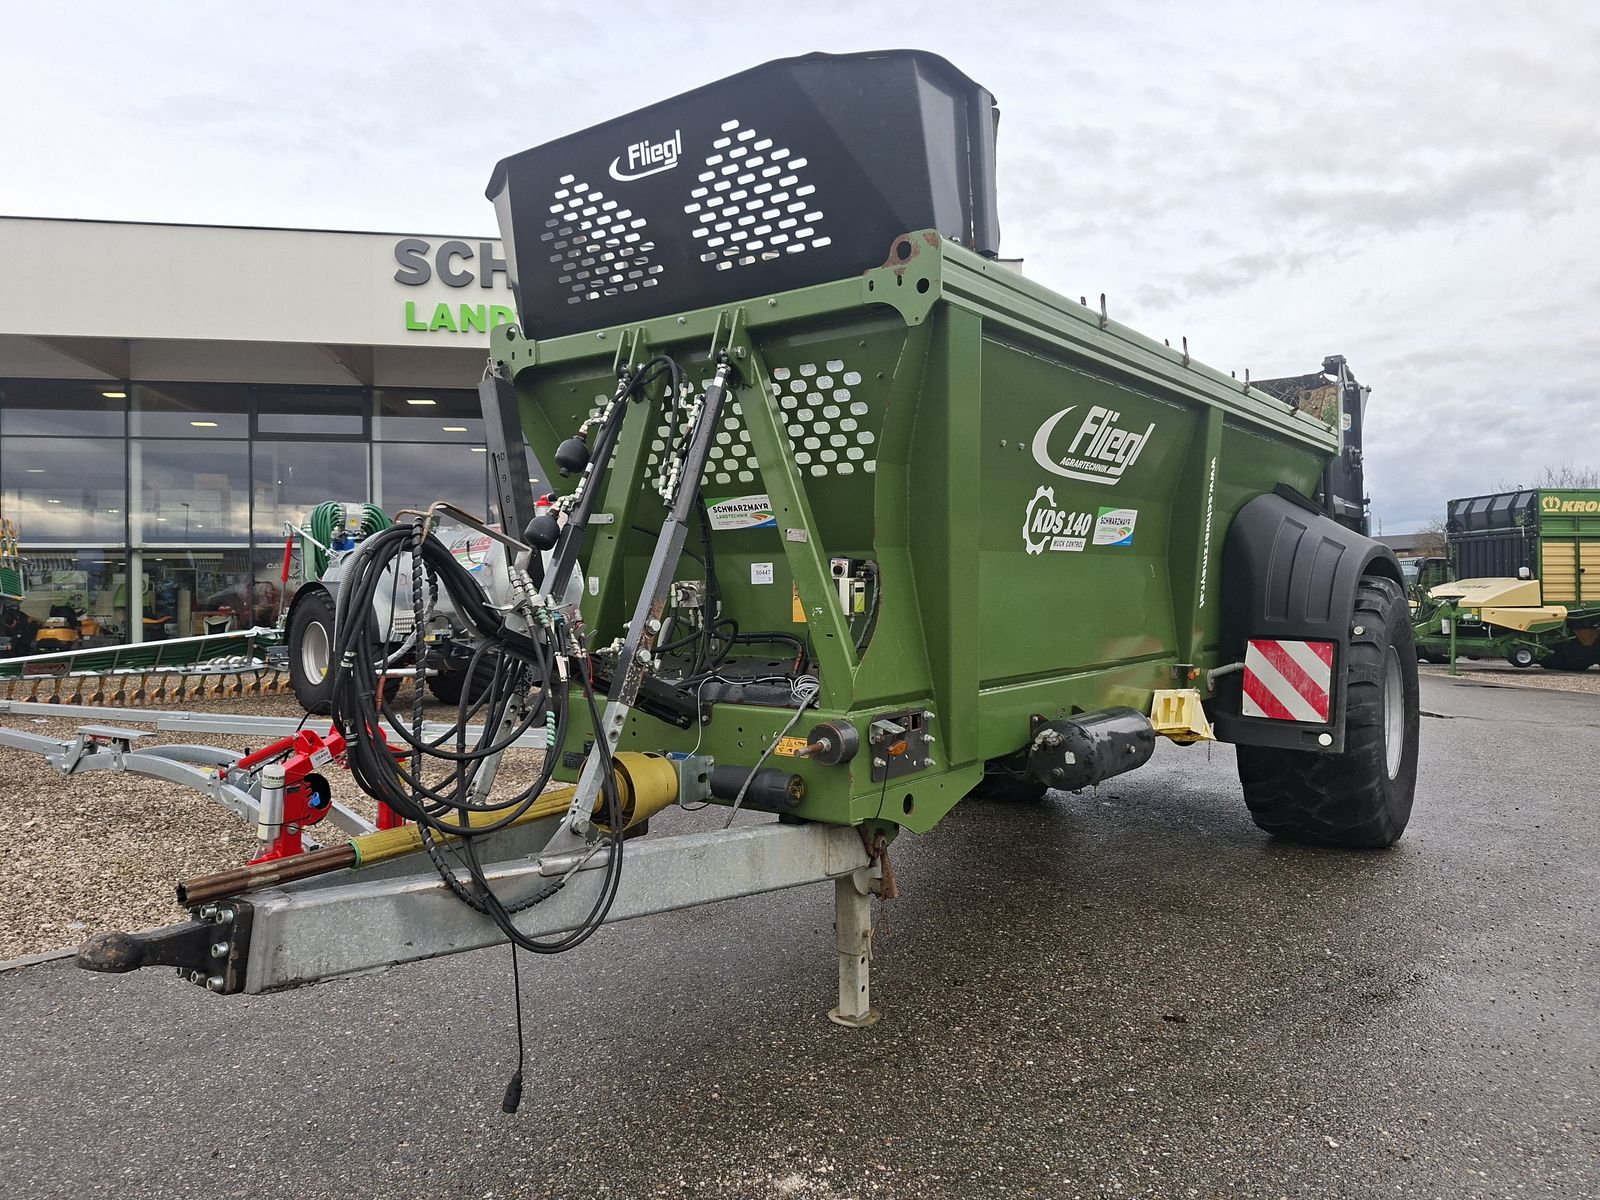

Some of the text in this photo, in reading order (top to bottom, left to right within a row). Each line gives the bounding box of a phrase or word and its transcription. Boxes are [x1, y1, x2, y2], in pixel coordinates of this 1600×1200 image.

[627, 129, 682, 170] Fliegl
[393, 238, 513, 289] SCH
[1067, 405, 1156, 476] Fliegl
[496, 452, 505, 463] 10
[1059, 456, 1109, 473] AGRARTECHNIK
[501, 474, 507, 482] 9
[505, 495, 511, 504] 8
[712, 502, 769, 514] SCHWARZMAYR
[1561, 500, 1600, 512] KRO
[507, 516, 513, 525] 7
[1030, 508, 1093, 537] KDS 140
[1100, 516, 1131, 526] SCHWARZMAYR
[1198, 456, 1217, 609] www.schwarzmayr.at
